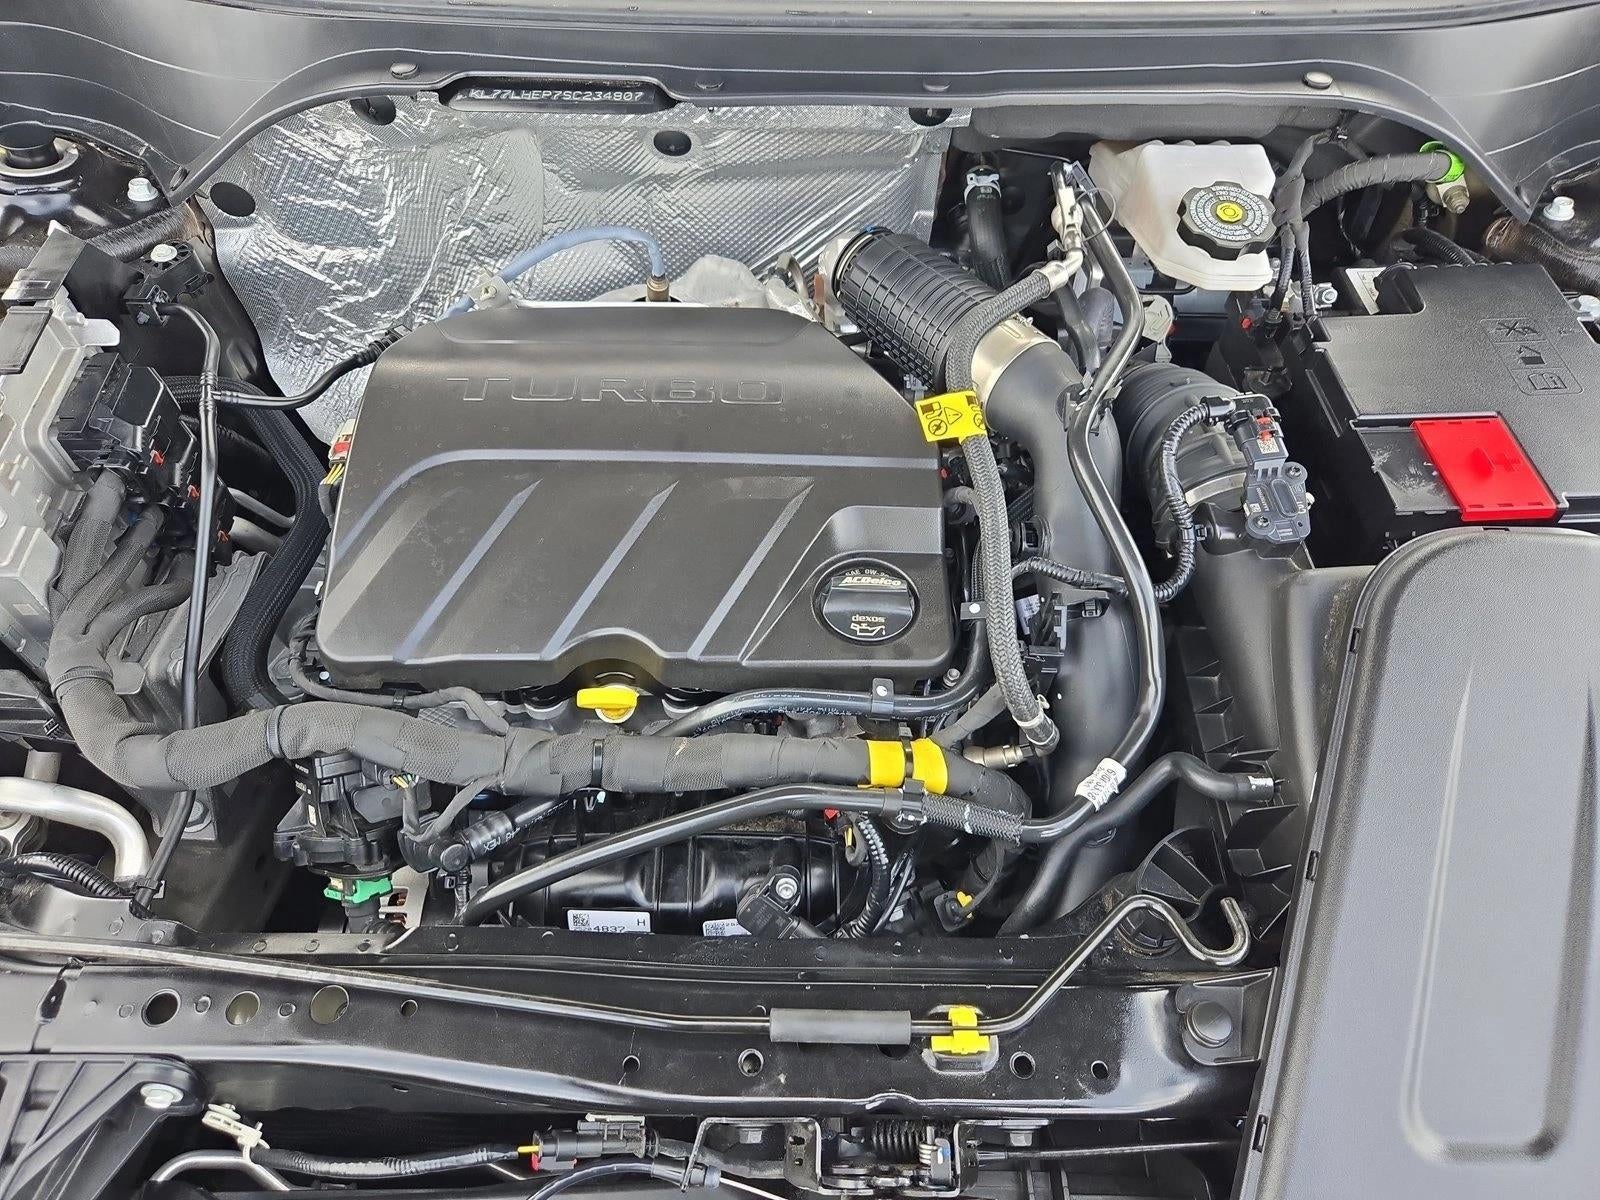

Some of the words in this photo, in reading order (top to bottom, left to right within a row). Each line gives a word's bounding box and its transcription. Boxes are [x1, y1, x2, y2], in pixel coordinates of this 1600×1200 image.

[446, 377, 784, 405] TURBO
[840, 576, 902, 587] ACDelco
[851, 614, 885, 623] dexos
[637, 918, 646, 926] H
